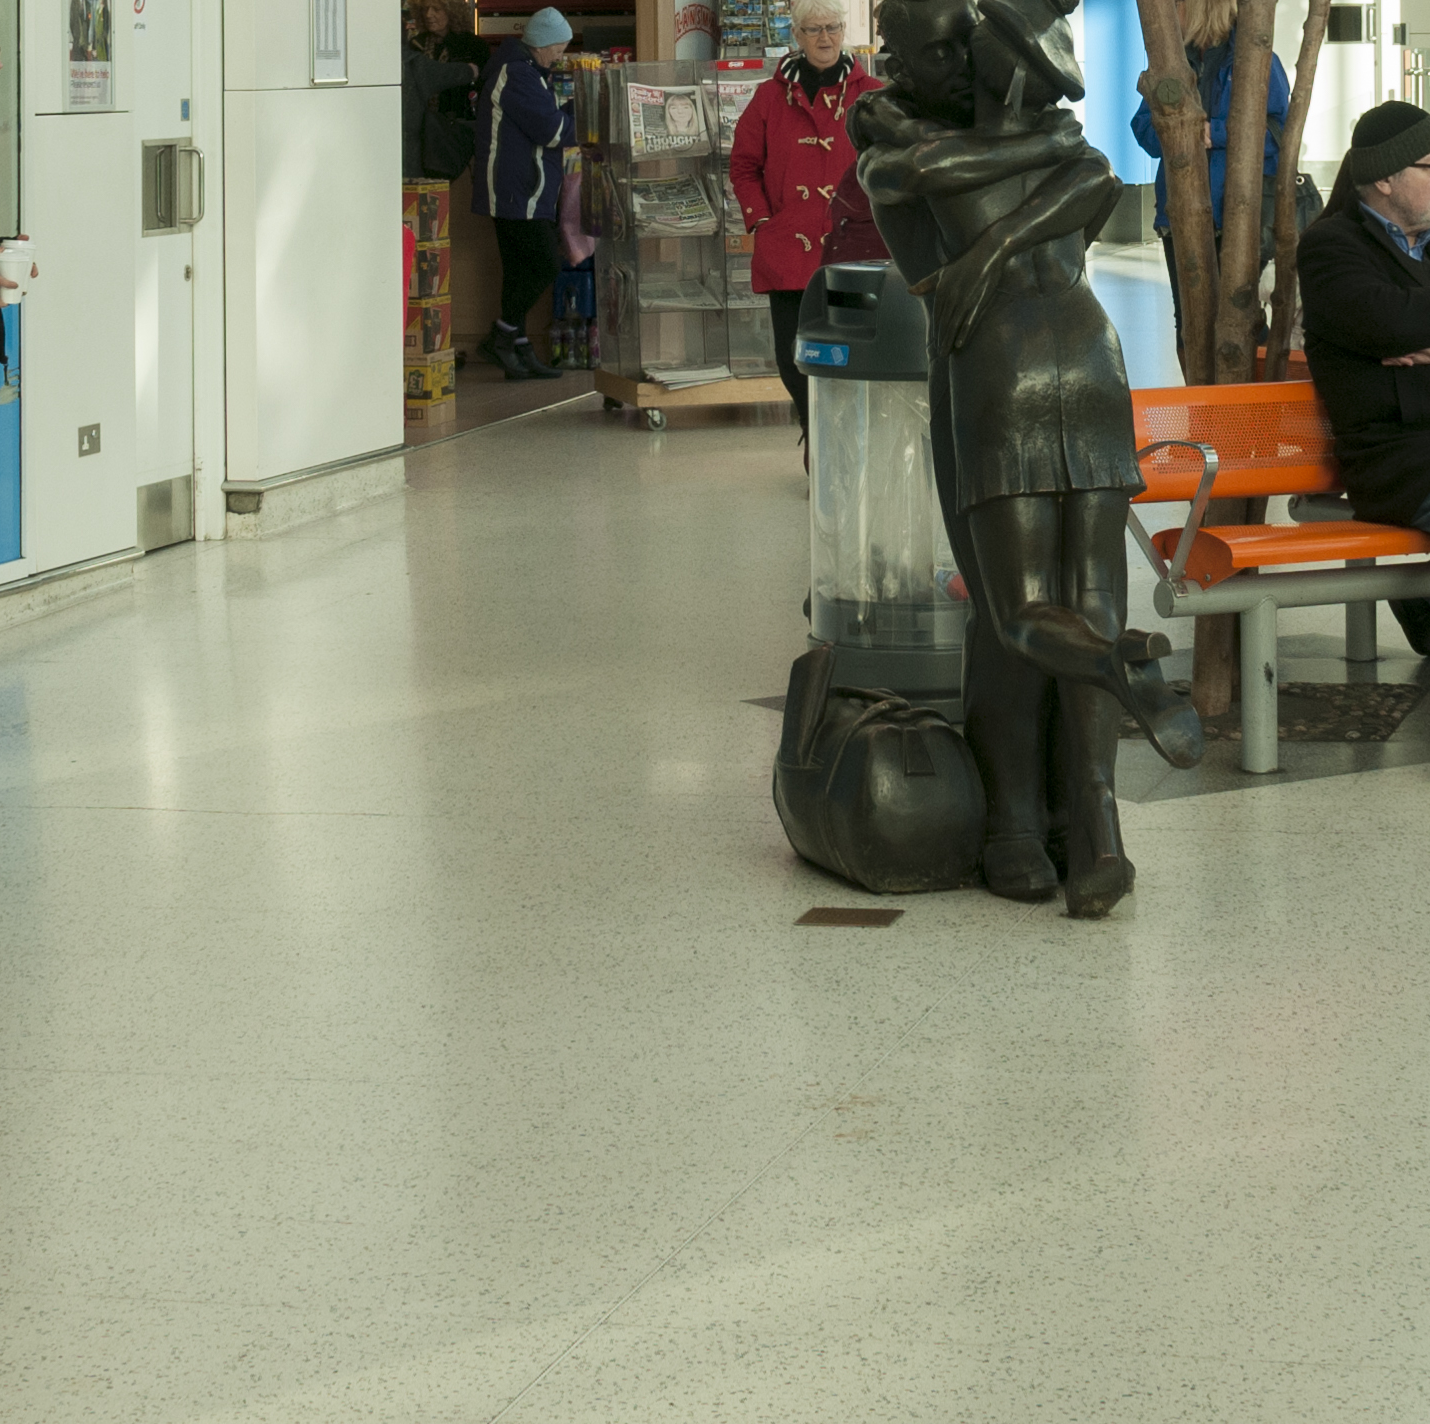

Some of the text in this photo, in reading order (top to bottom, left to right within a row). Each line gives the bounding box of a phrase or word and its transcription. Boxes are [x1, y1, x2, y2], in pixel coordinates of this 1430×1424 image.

[631, 88, 651, 97] Daily
[631, 93, 663, 103] Record
[645, 135, 700, 145] THOUGHT
[805, 349, 820, 359] paper
